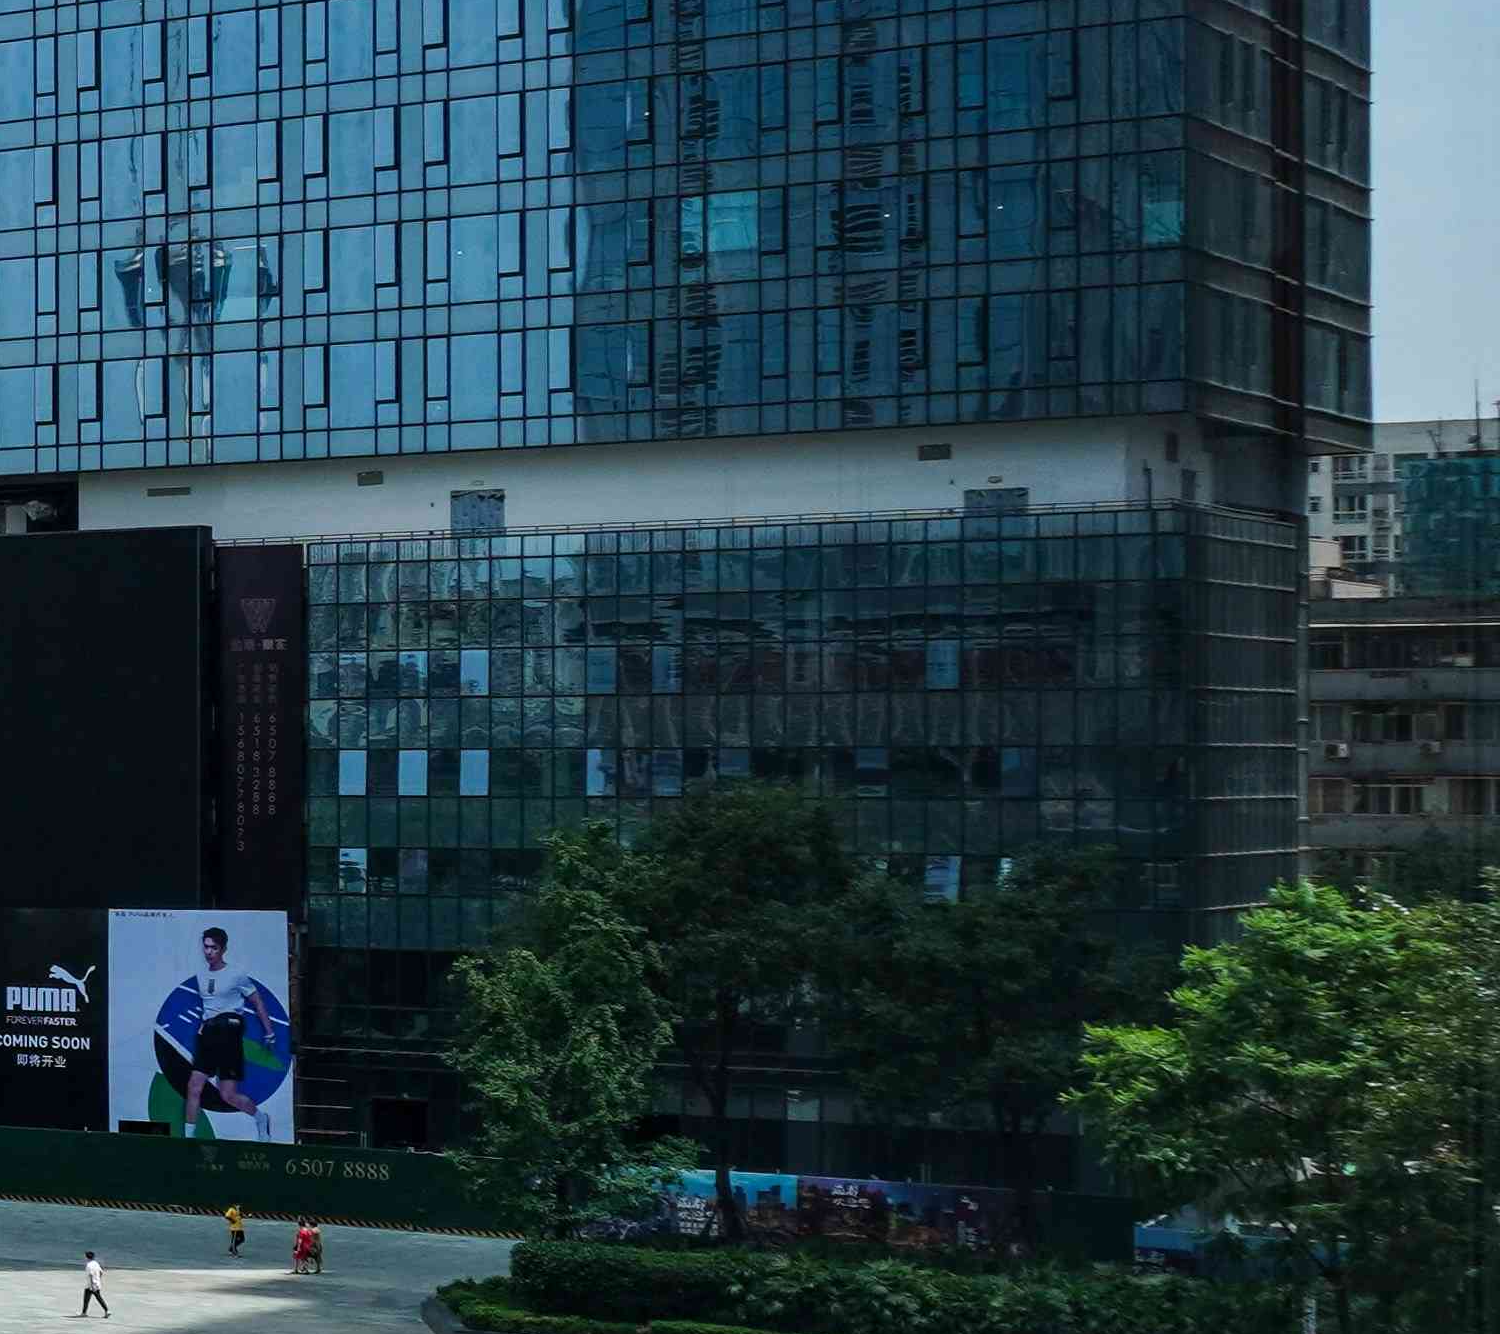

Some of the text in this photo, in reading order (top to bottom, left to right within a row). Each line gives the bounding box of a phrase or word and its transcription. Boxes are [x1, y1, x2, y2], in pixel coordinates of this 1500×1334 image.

[6, 987, 77, 1012] PUMA
[51, 1036, 90, 1050] SOON
[16, 1054, 66, 1067] 即将开业
[286, 1159, 334, 1177] 6507
[343, 1161, 389, 1181] 8888
